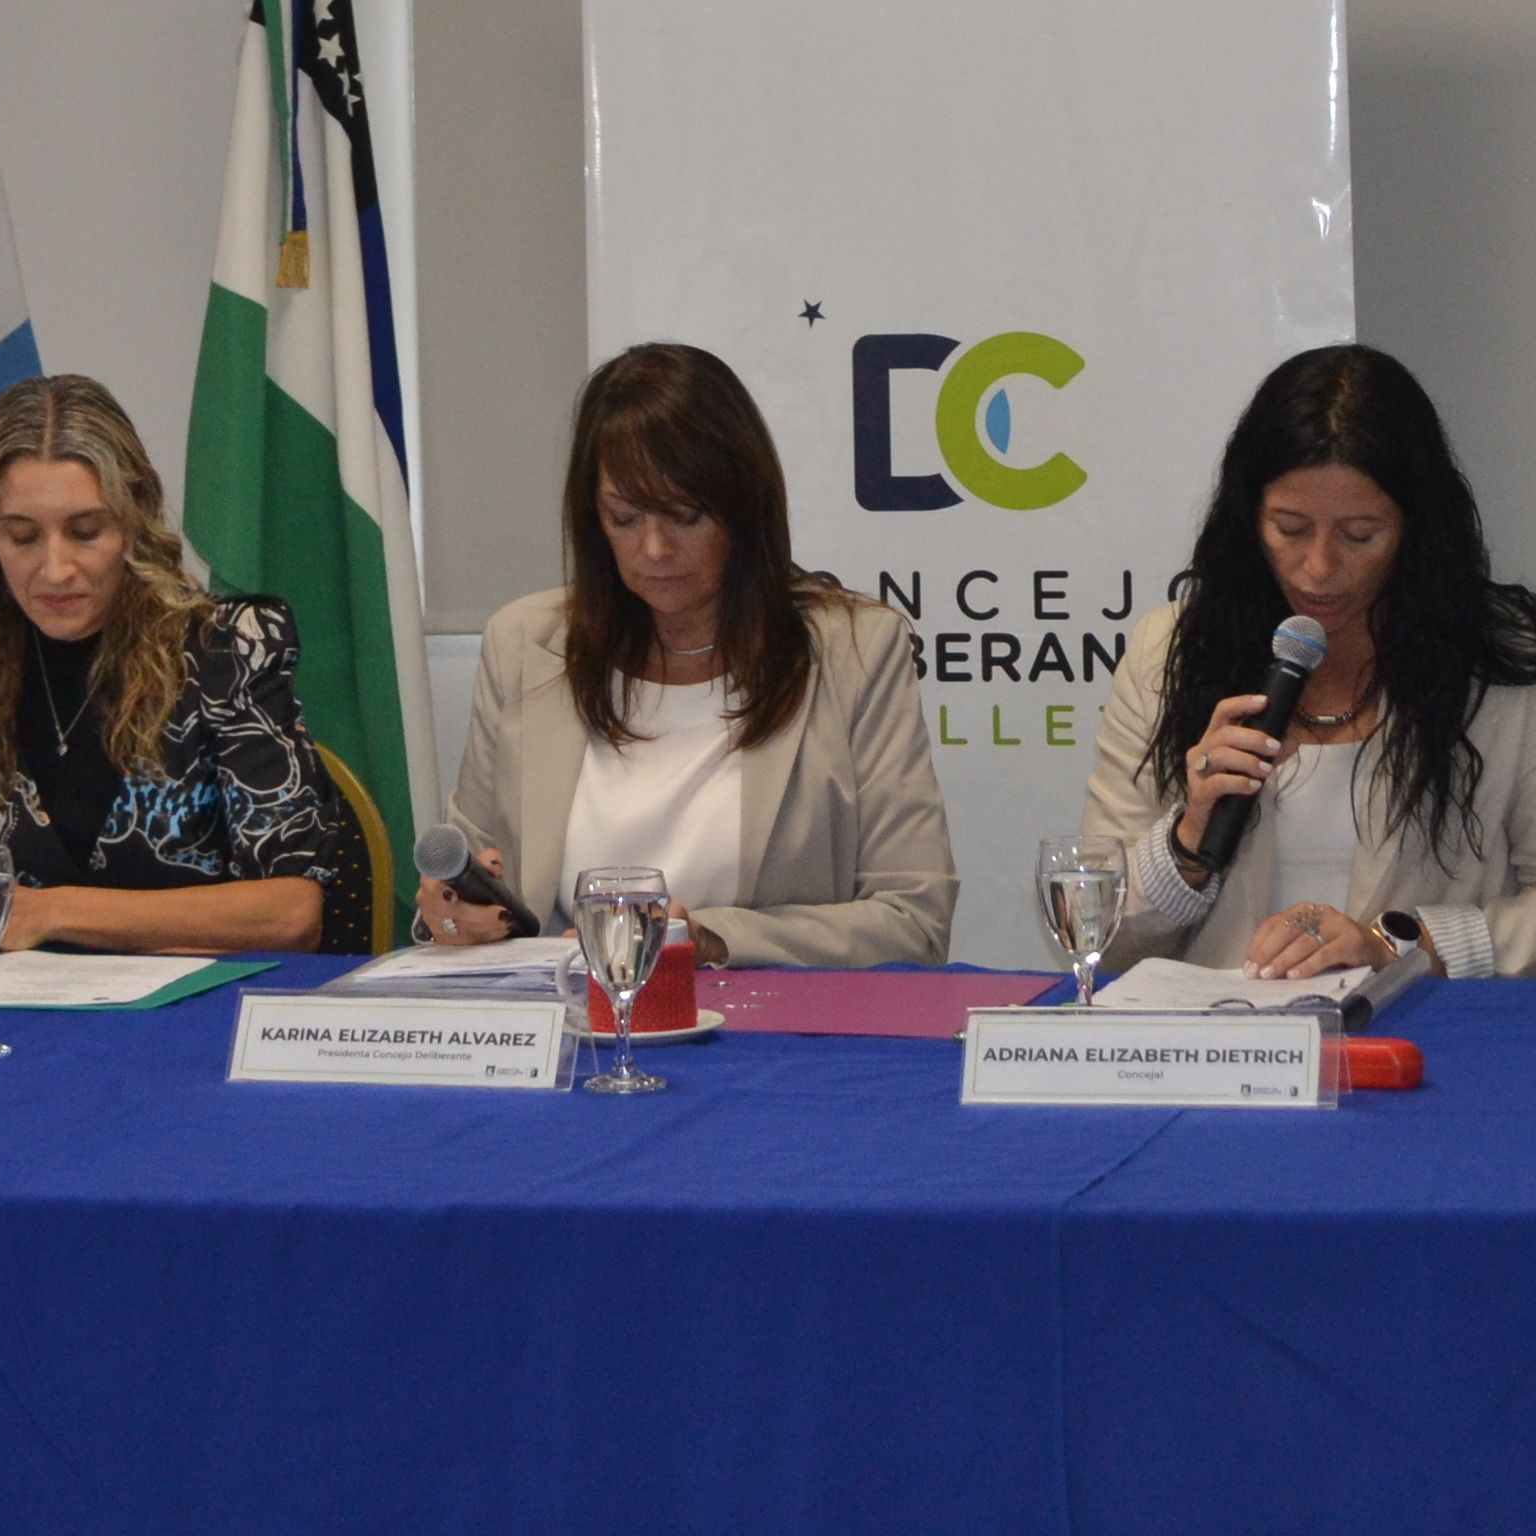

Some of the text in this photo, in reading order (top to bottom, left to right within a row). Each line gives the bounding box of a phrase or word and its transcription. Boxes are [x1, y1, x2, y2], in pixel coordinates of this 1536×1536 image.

[807, 570, 1199, 621] NCEJ
[938, 704, 1106, 746] LLE
[261, 1026, 536, 1046] KARINA ELIZABETH ALVAREZ
[317, 1048, 370, 1059] Presidenta
[414, 1050, 473, 1062] Deliberante
[983, 1047, 1305, 1064] ADRIANA ELIZABETH DIETRICH
[1117, 1069, 1164, 1081] Concejal
